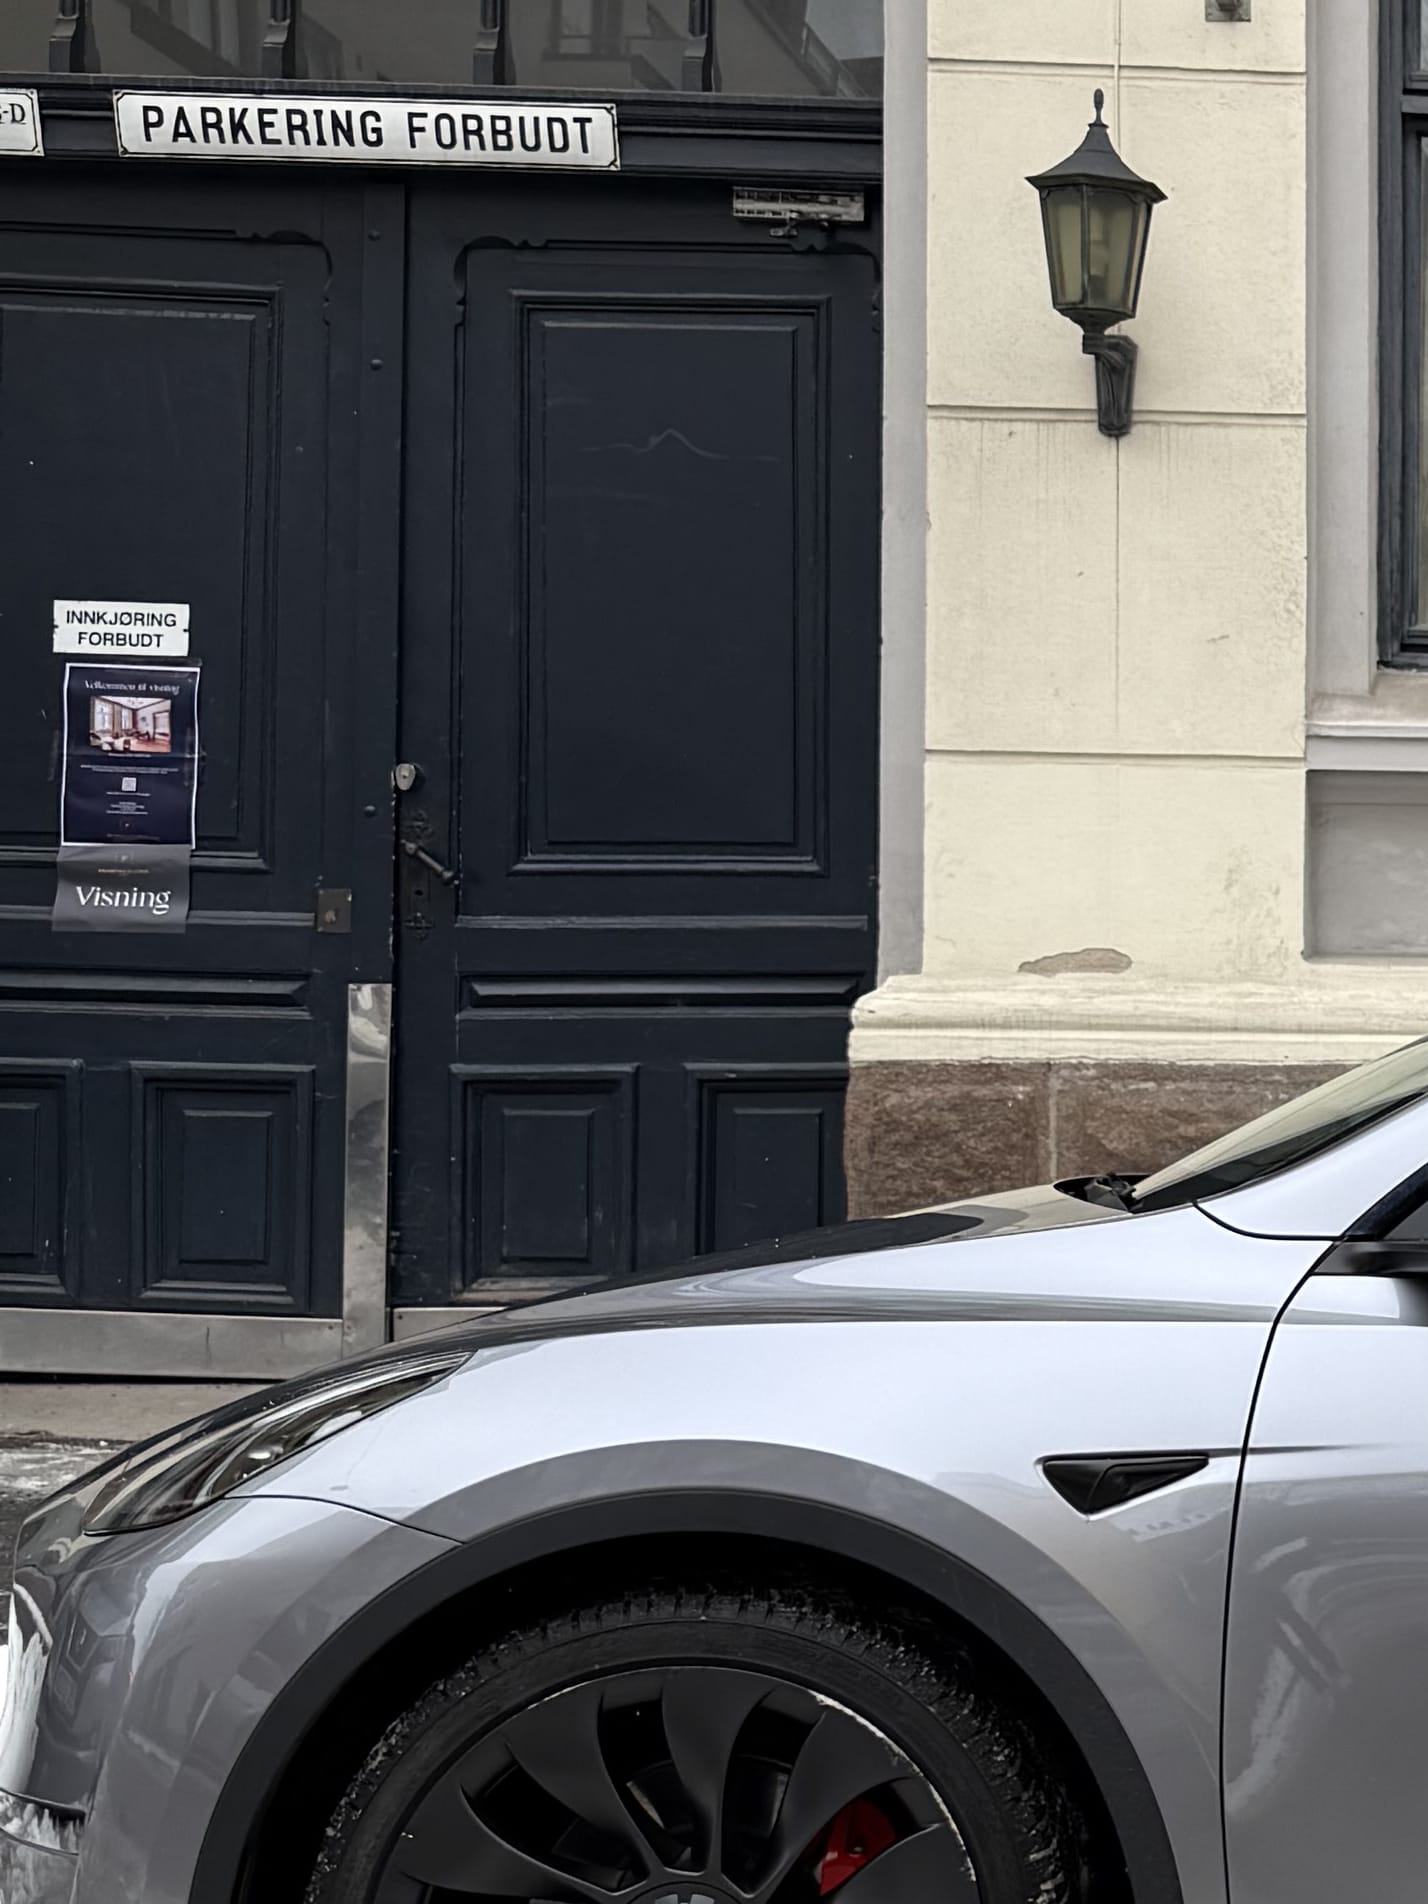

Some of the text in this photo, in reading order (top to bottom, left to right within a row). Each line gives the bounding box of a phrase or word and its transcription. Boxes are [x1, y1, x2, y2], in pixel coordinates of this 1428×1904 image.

[142, 106, 593, 154] PARKERING FORBUDT
[66, 610, 177, 627] INNKJØRING
[78, 632, 164, 648] FORBUDT
[76, 886, 171, 915] Visning
